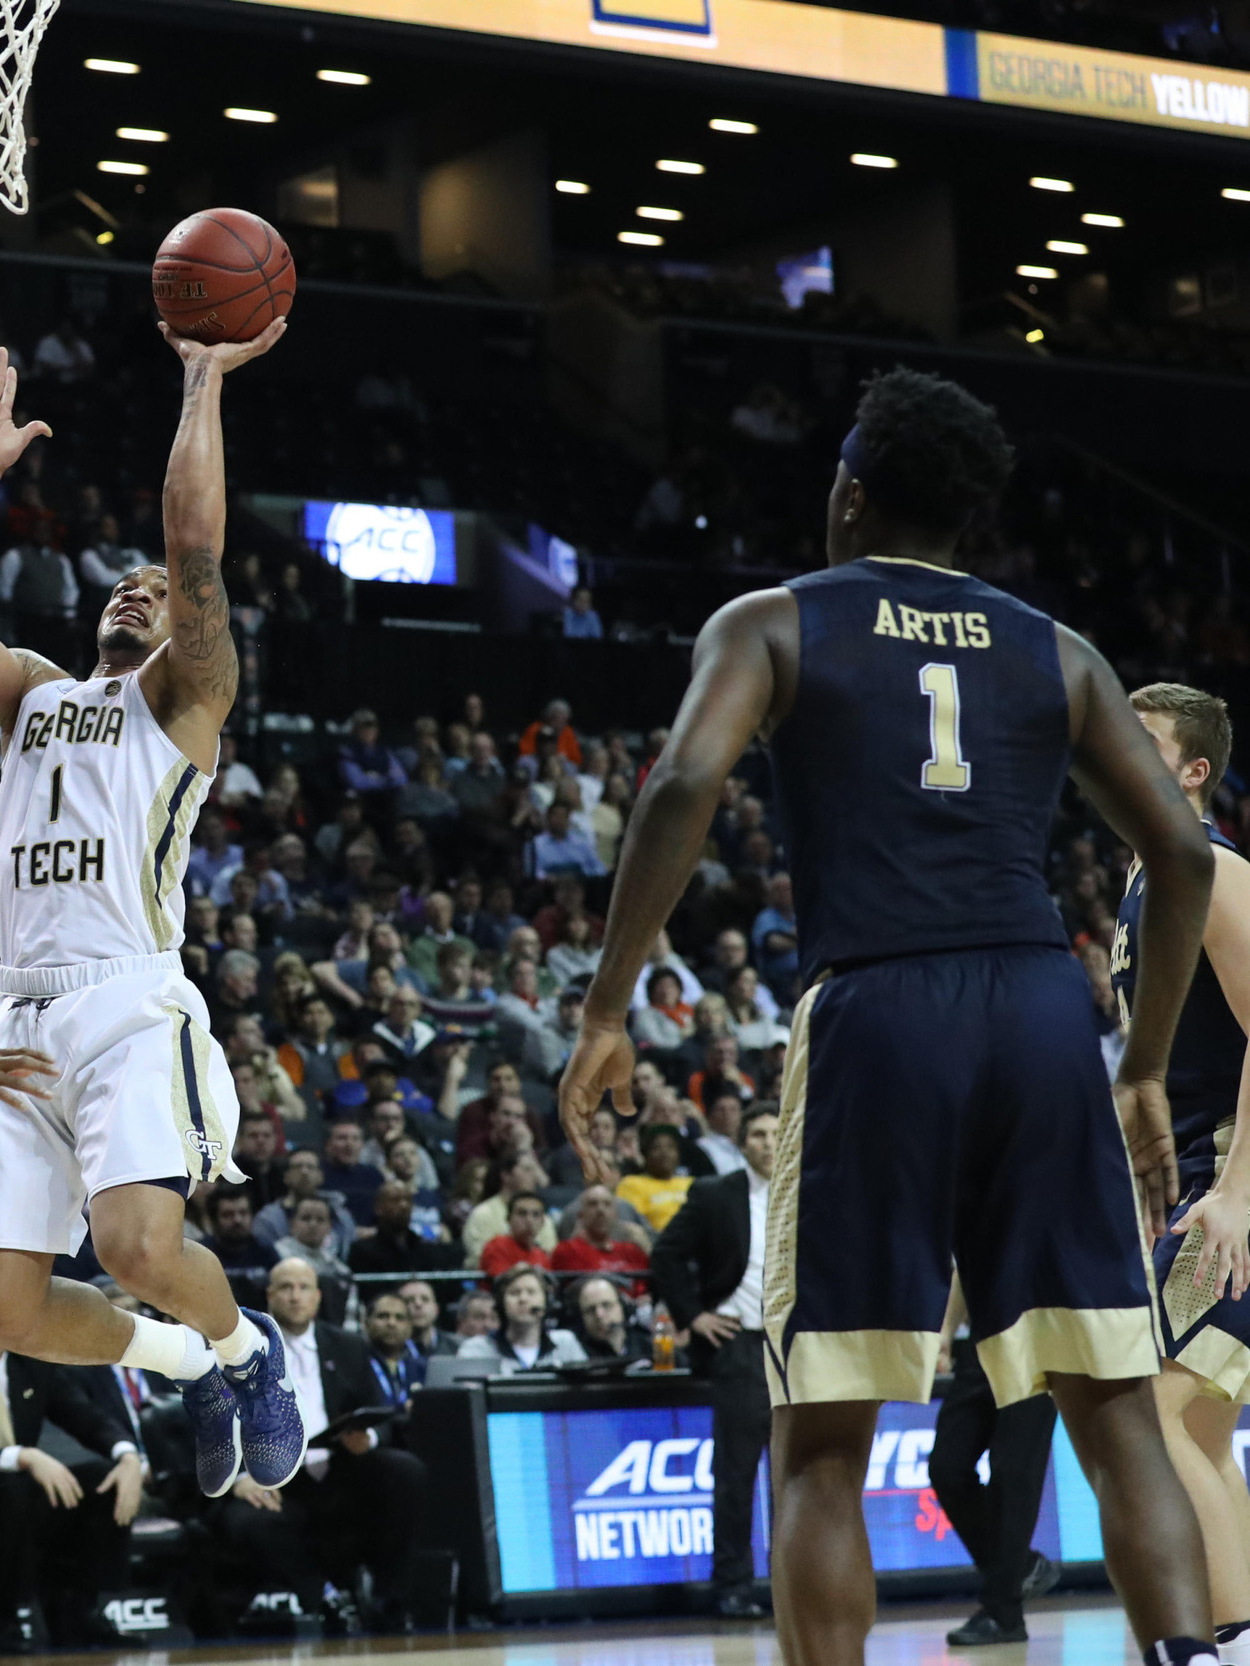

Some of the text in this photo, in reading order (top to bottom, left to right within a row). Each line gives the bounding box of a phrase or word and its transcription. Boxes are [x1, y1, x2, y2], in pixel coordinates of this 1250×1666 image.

[989, 51, 1249, 127] GEORGIA TECH YELLOW
[346, 527, 422, 554] ACC
[873, 598, 992, 649] ARTIS
[20, 699, 124, 754] GERGIA
[918, 662, 971, 791] 1
[48, 763, 64, 824] 1
[11, 838, 105, 890] TECH
[574, 1506, 715, 1562] NETWOR
[103, 1597, 169, 1622] ACC
